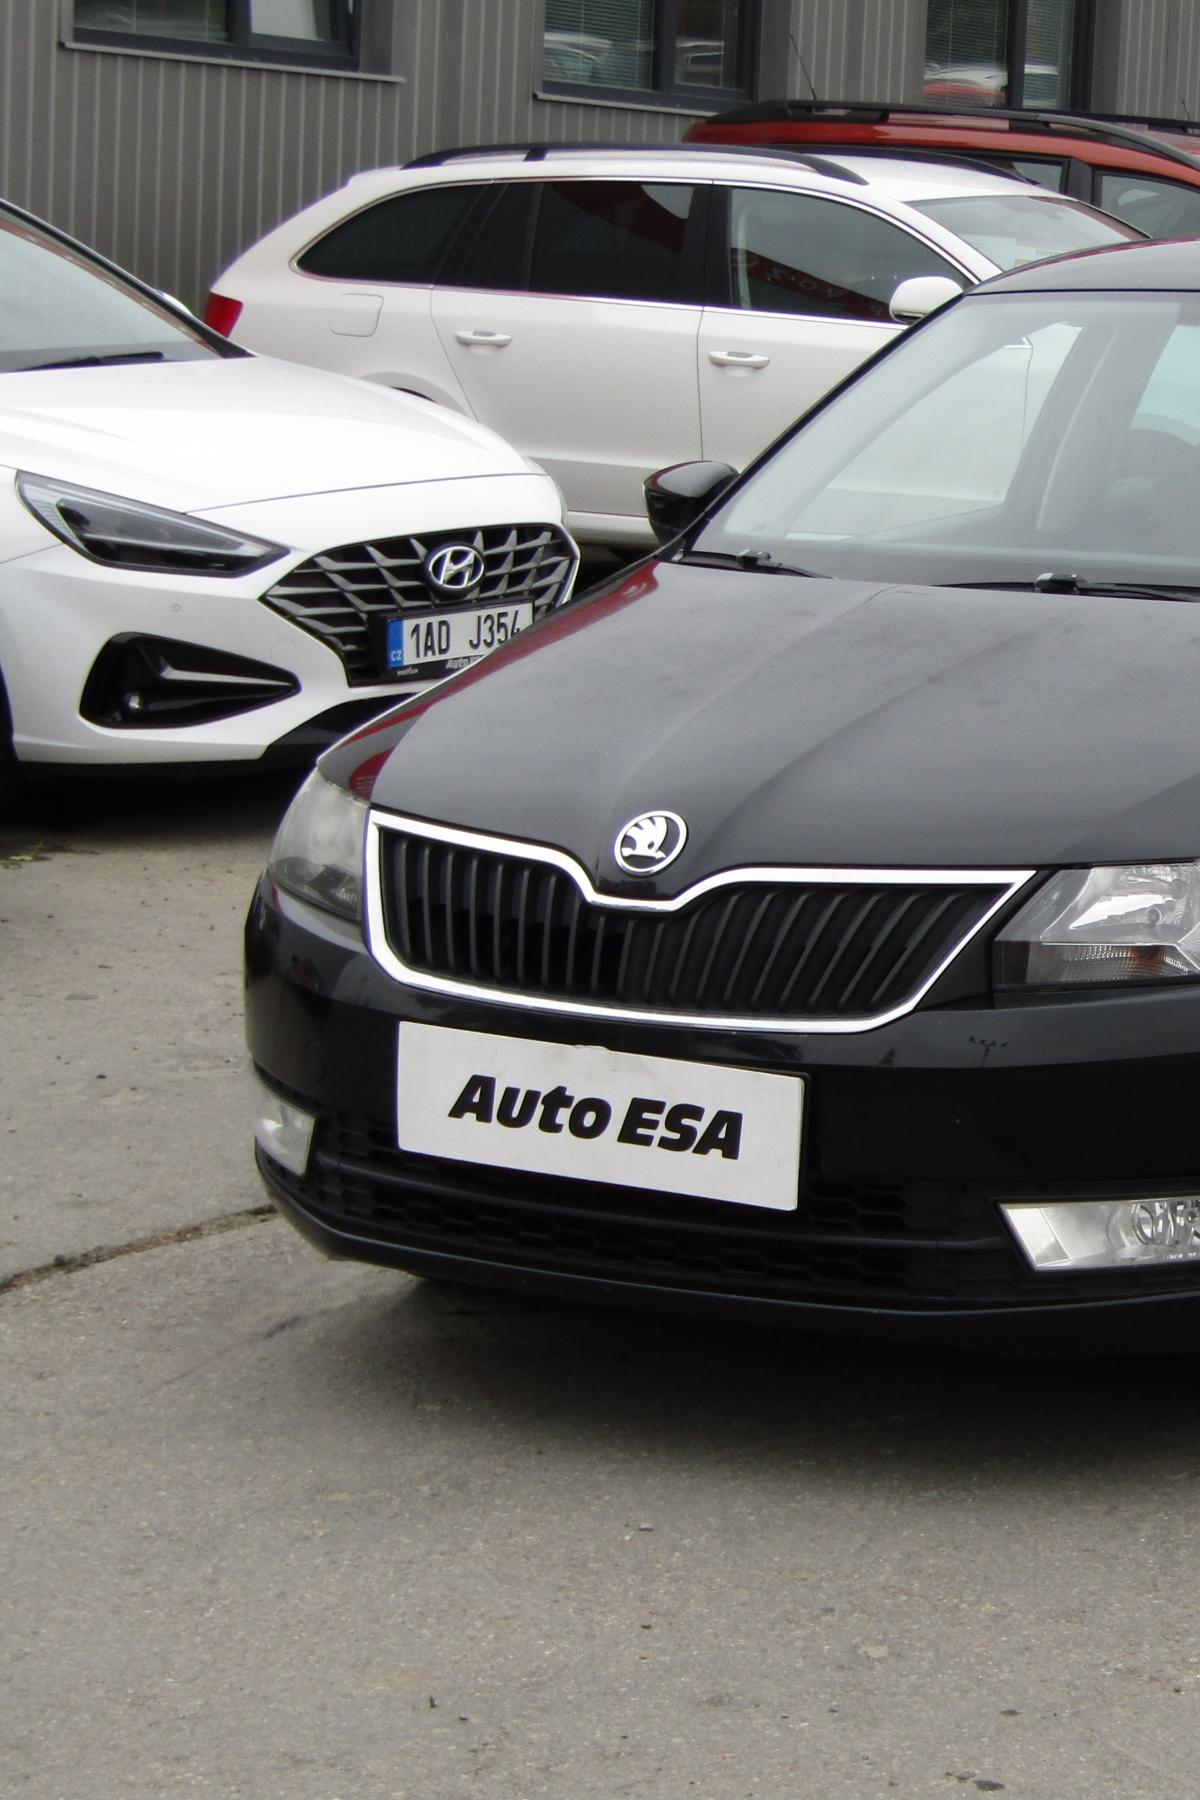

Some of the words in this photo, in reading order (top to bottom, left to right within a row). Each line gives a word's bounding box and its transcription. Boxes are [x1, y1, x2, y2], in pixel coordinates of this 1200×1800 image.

[390, 650, 402, 661] CZ
[410, 619, 450, 659] 1AD
[469, 609, 521, 650] J354
[448, 1073, 612, 1140] Auto
[616, 1096, 744, 1160] ESA
